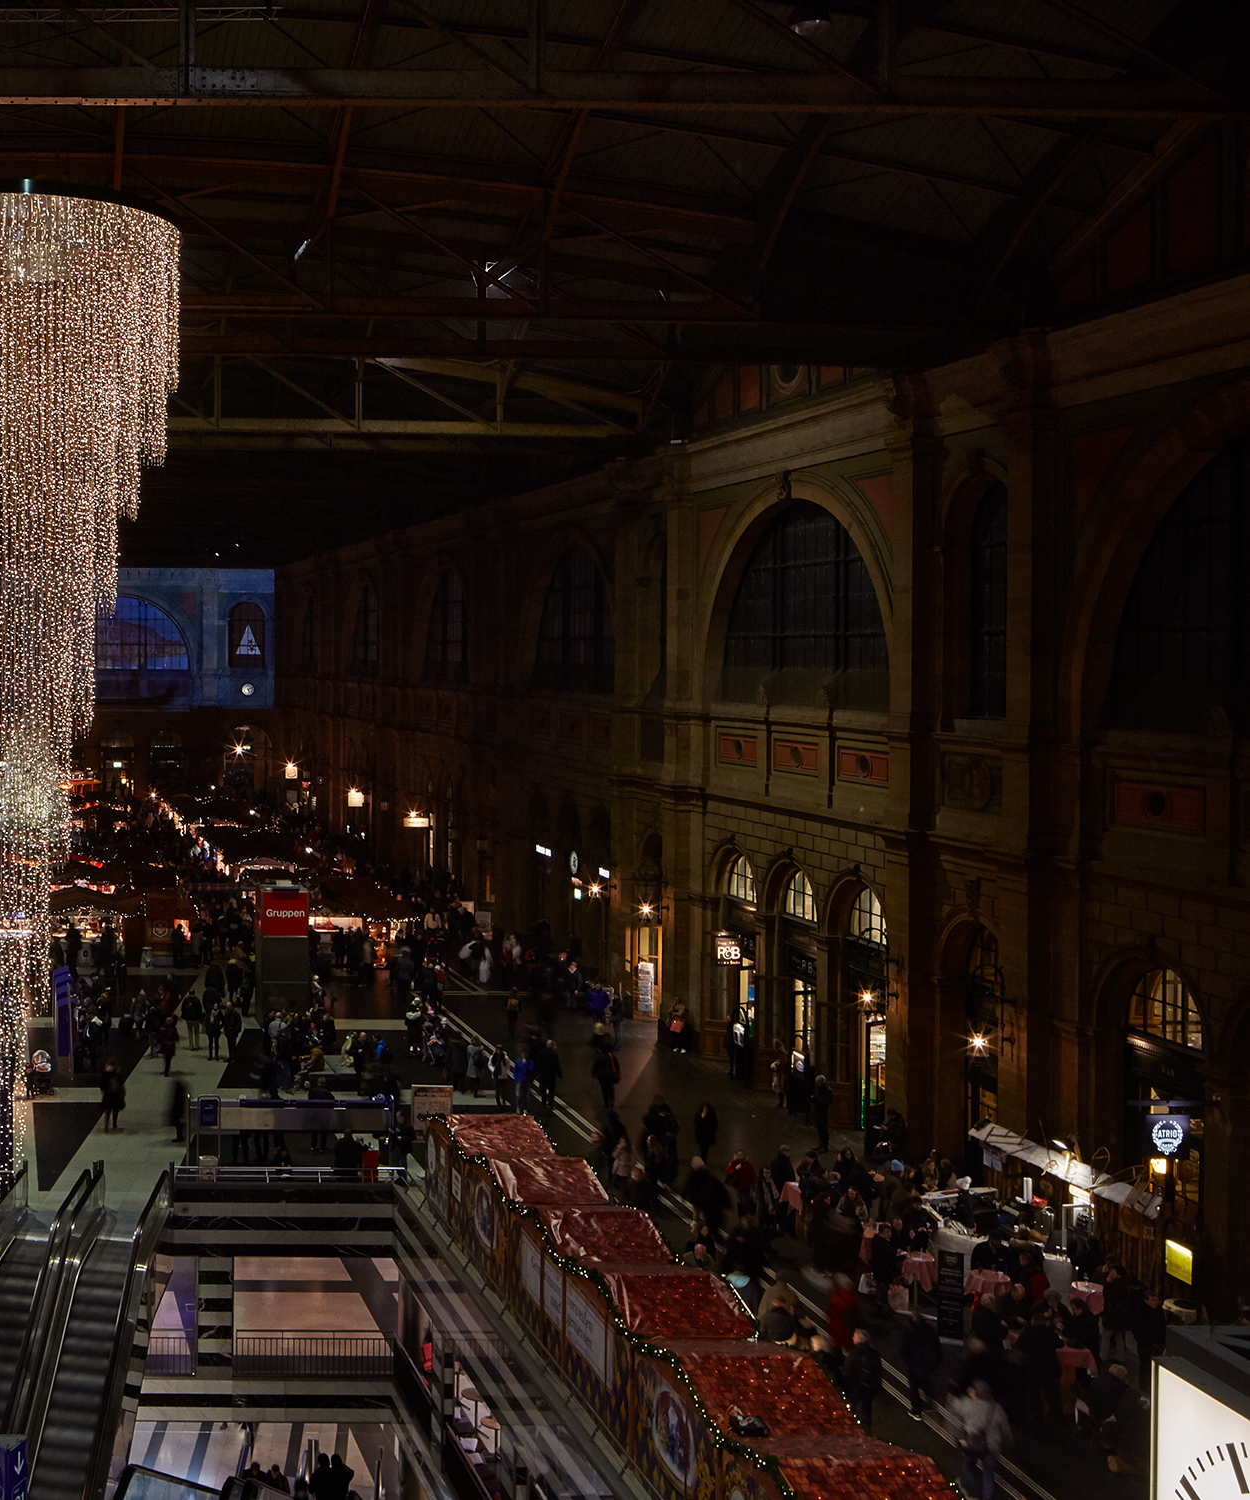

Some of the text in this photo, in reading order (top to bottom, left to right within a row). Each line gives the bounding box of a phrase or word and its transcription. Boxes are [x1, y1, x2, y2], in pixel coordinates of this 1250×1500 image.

[266, 909, 306, 918] Gruppen
[717, 946, 741, 959] P&B
[1157, 1129, 1178, 1139] ATRIO
